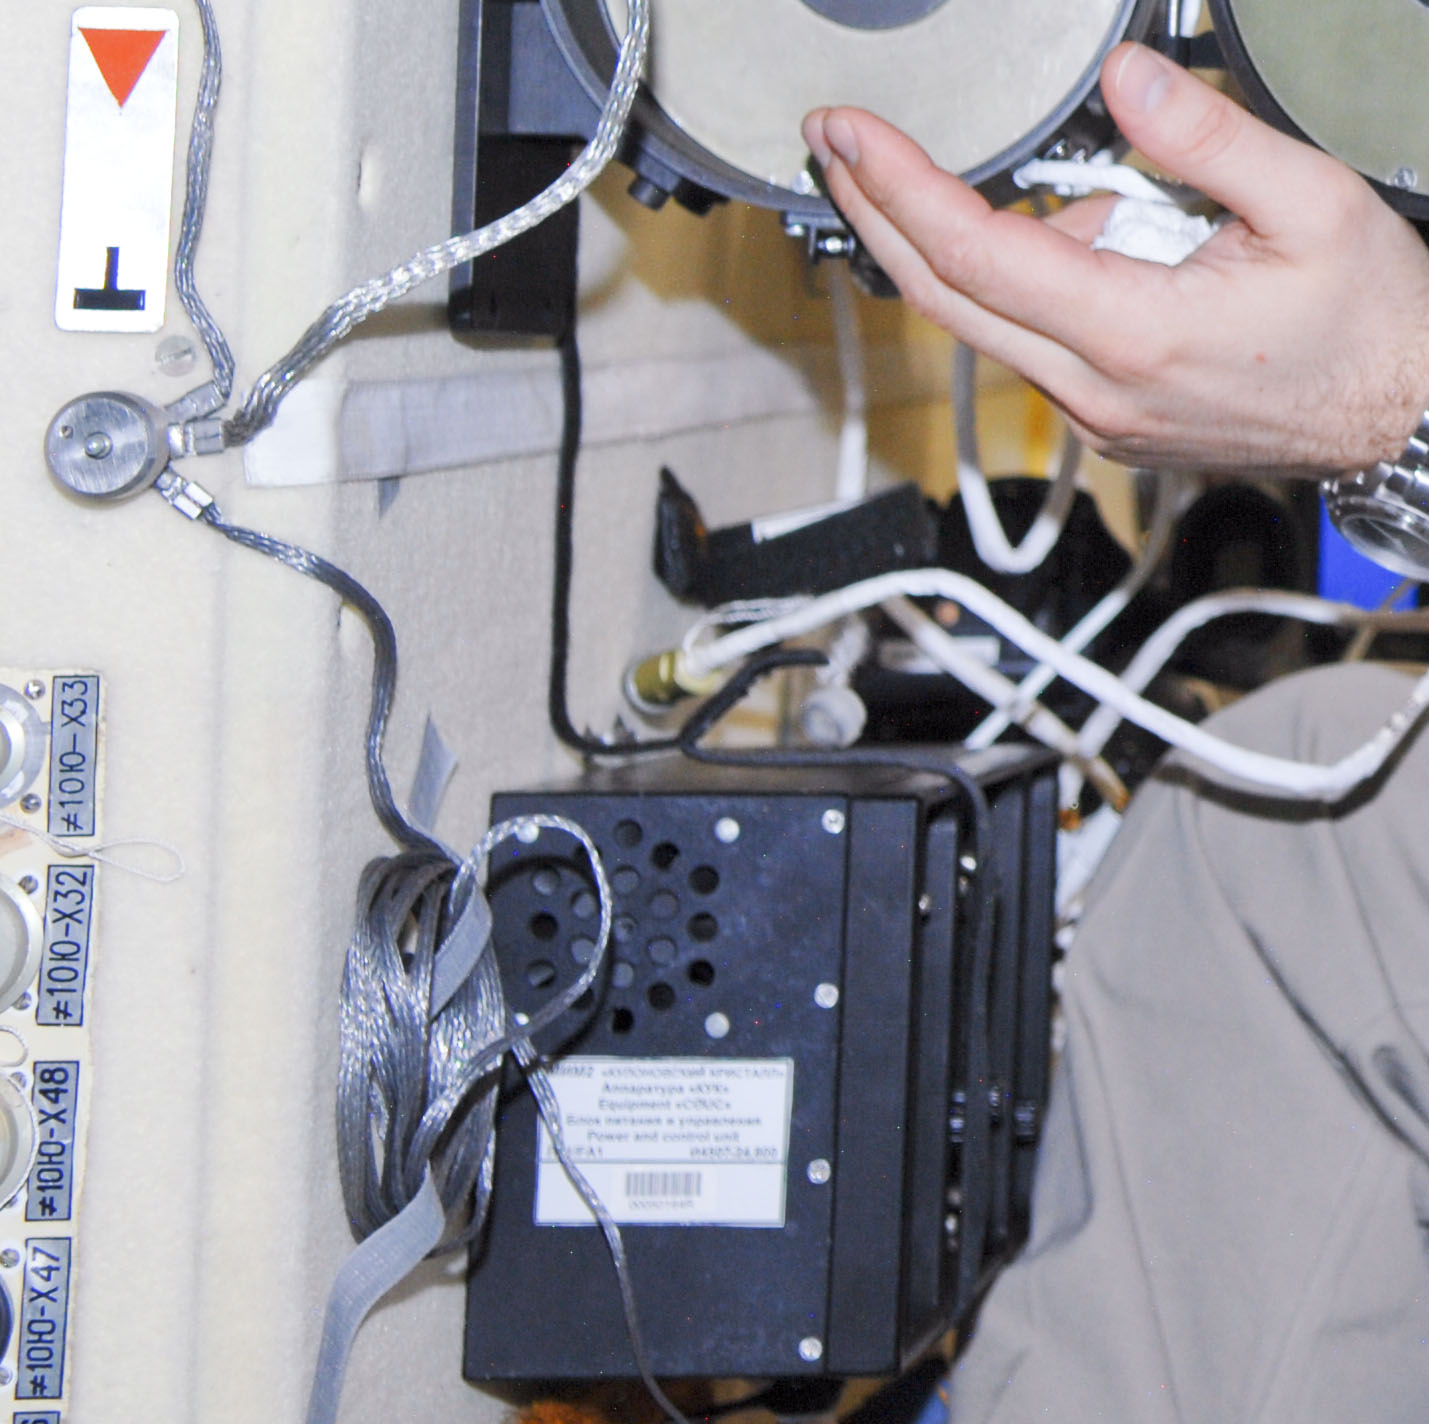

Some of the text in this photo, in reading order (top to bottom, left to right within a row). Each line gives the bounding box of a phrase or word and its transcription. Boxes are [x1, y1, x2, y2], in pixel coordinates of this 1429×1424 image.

[598, 1098, 671, 1113] Equipment
[586, 1130, 630, 1143] Power
[633, 1131, 659, 1143] and
[662, 1131, 711, 1143] control
